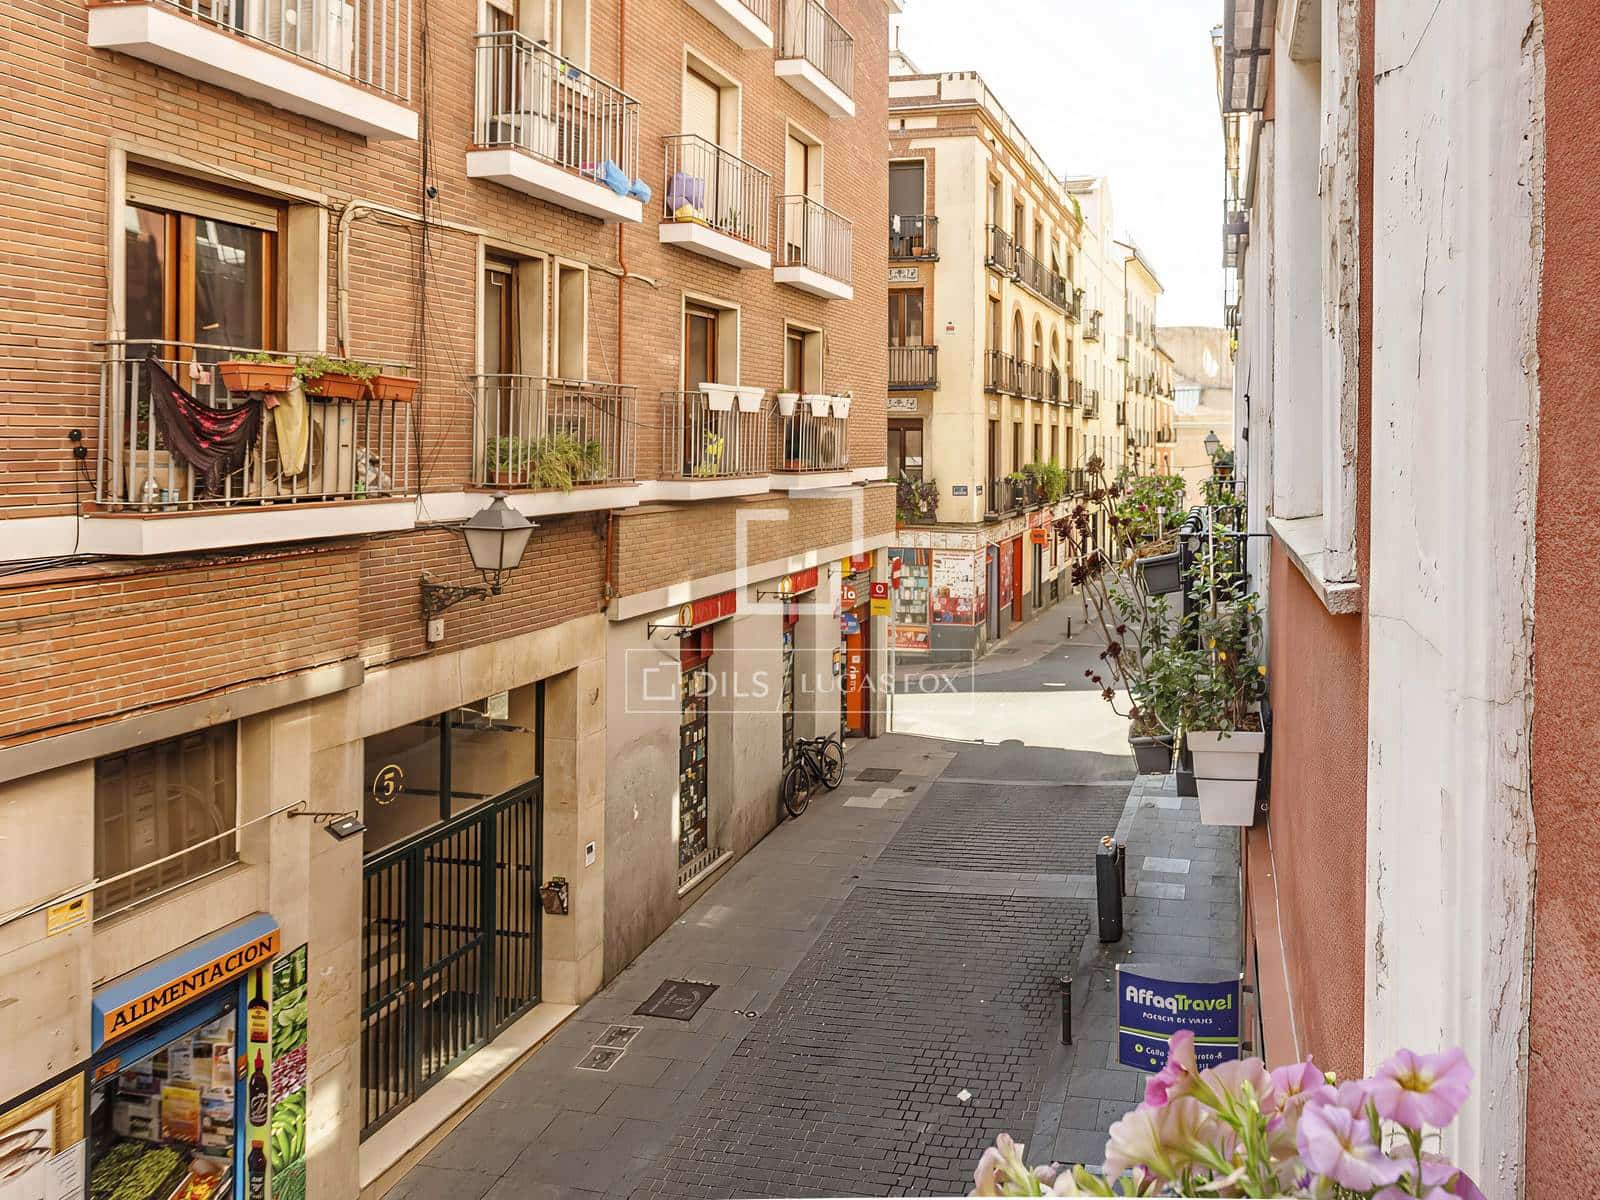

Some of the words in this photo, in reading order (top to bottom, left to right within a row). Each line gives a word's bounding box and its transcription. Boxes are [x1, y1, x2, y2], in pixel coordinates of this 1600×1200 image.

[383, 772, 395, 796] 5
[110, 936, 273, 1033] ALIMENTACION
[1126, 985, 1232, 1014] AffaqTravel
